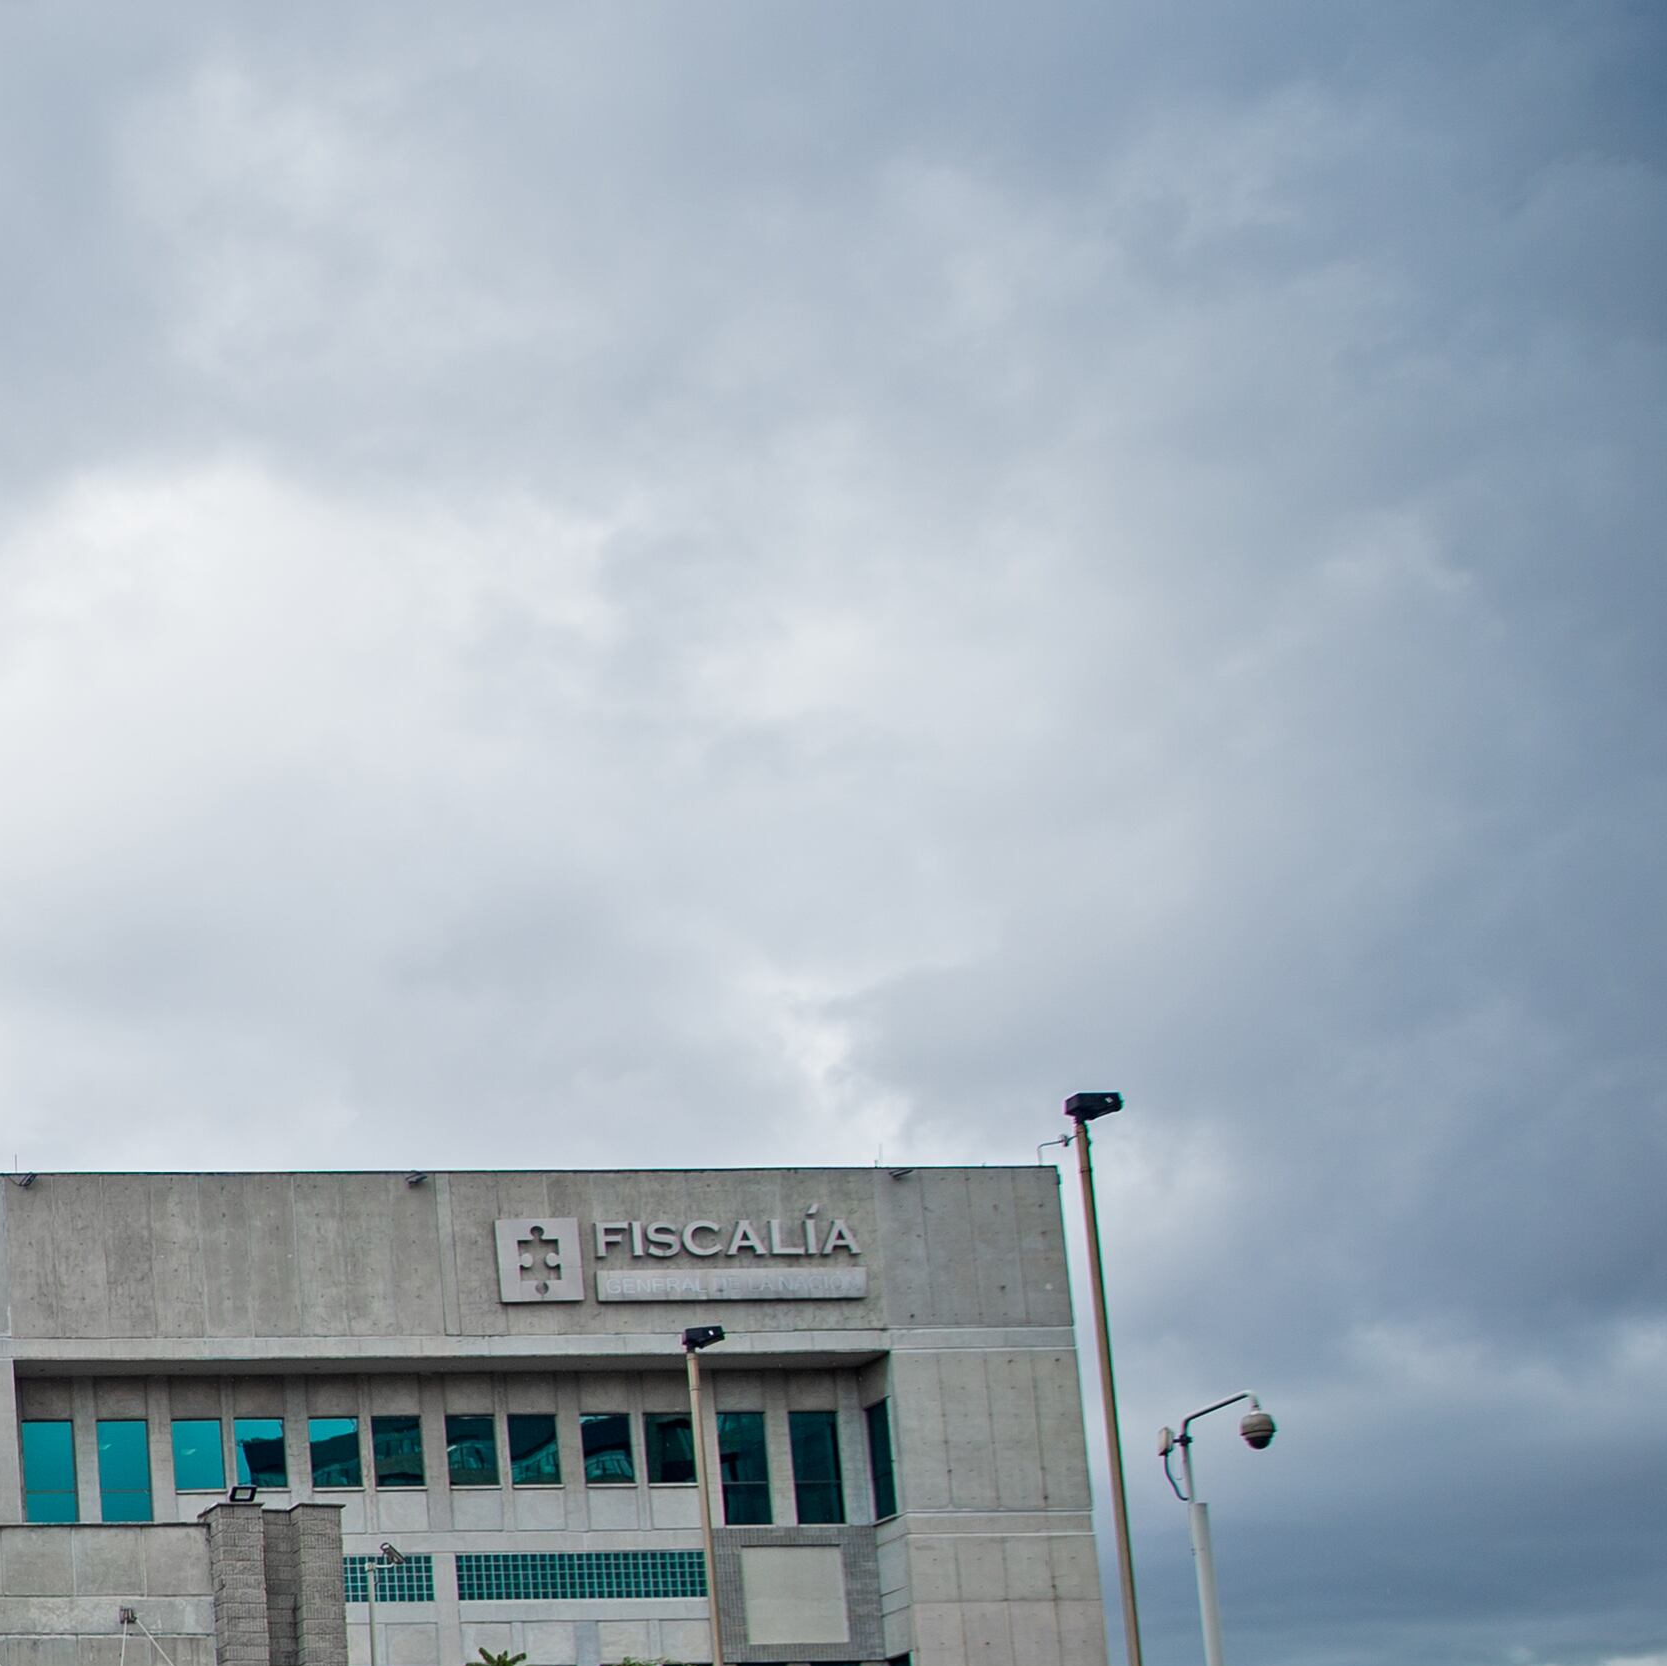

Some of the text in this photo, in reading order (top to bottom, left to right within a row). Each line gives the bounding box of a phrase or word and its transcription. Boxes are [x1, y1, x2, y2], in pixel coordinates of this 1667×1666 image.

[593, 1203, 862, 1258] FISCALÍA
[605, 1276, 708, 1295] GENERAL
[712, 1276, 740, 1293] DE
[747, 1275, 772, 1292] LA
